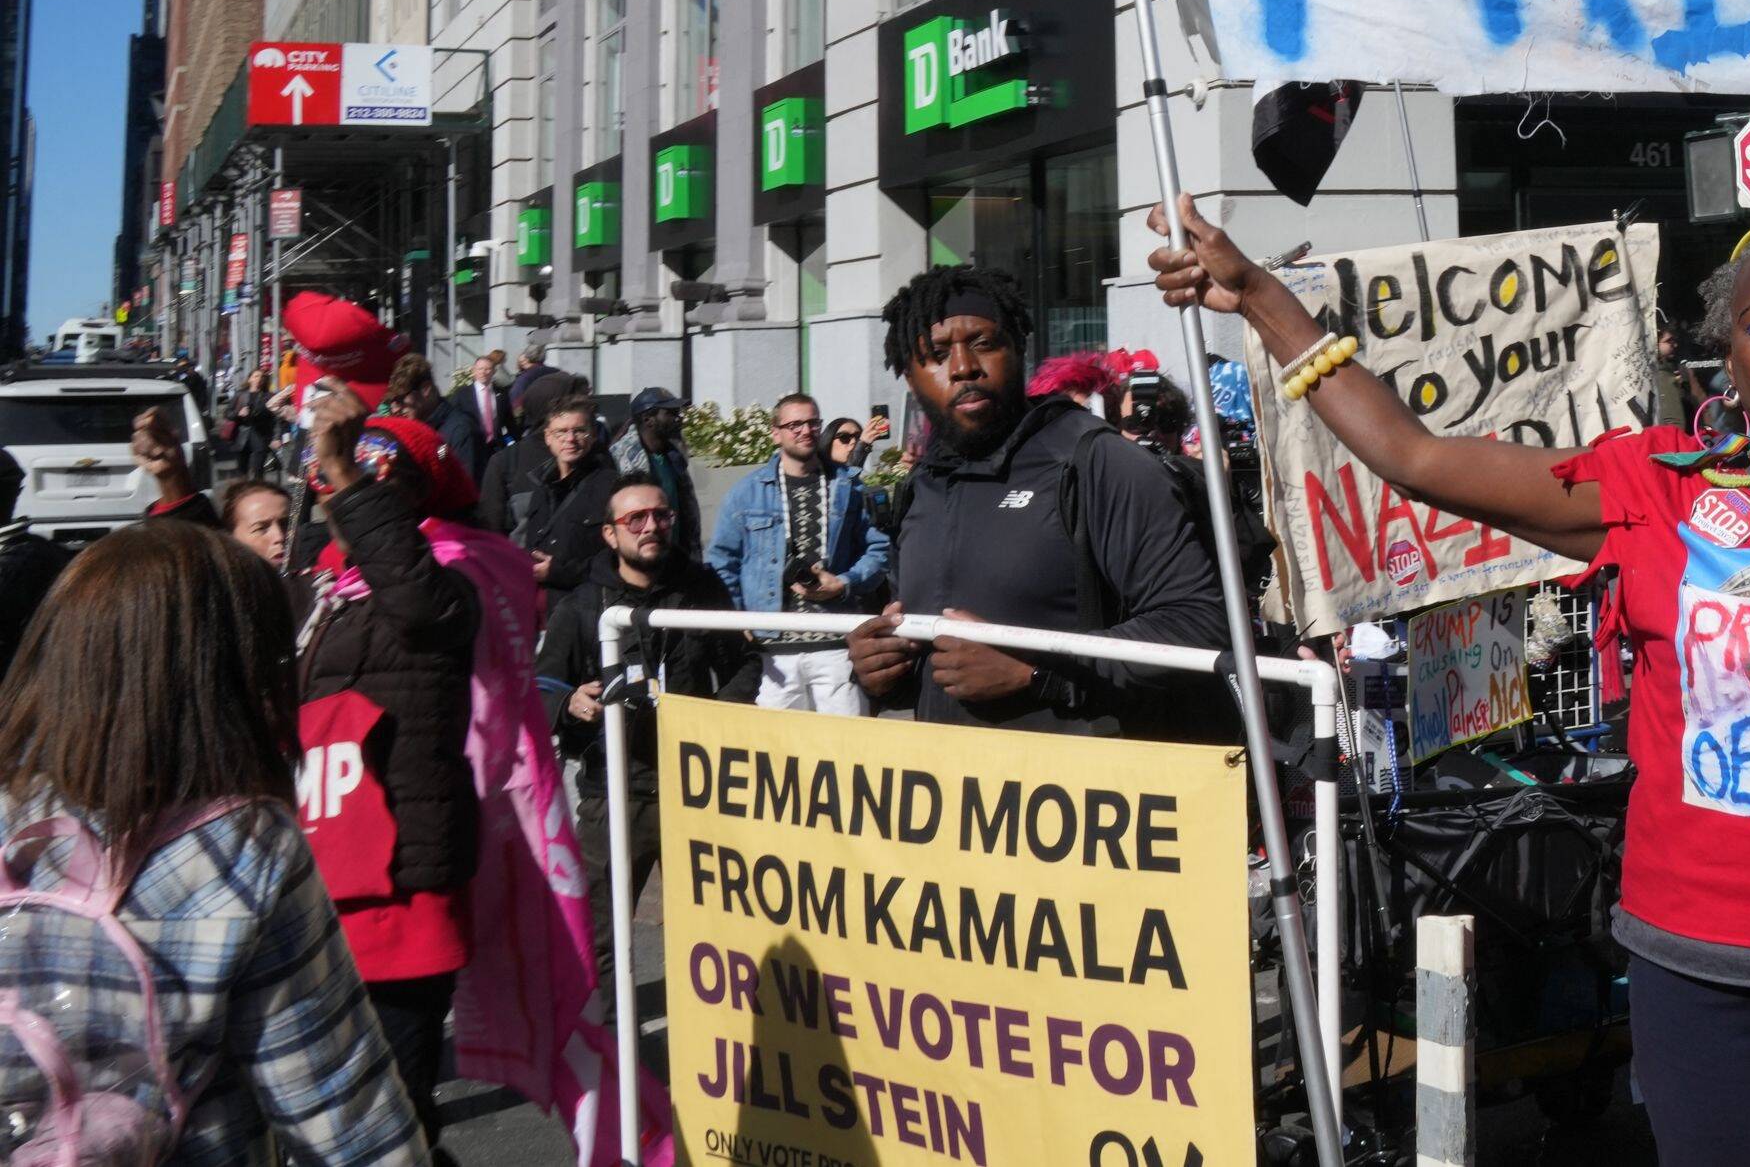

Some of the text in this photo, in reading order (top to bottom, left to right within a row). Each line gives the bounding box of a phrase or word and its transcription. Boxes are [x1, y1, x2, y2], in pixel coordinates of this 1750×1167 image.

[287, 50, 329, 63] CITY
[908, 8, 1010, 109] TD Bank
[763, 118, 786, 172] TD
[1629, 141, 1672, 167] 461
[1446, 323, 1593, 429] your
[1697, 495, 1749, 535] STOP
[1387, 550, 1422, 577] STOP
[1490, 591, 1516, 631] IS
[679, 741, 943, 845] DEMAND
[958, 776, 1181, 875] MORE
[689, 839, 848, 940] FROM
[863, 872, 1188, 991] KAMALA
[689, 942, 1199, 1108] OR WE VOTE FOR
[697, 1037, 988, 1167] JILL STEIN
[705, 1128, 753, 1162] ONLY
[756, 1143, 812, 1167] VOTE
